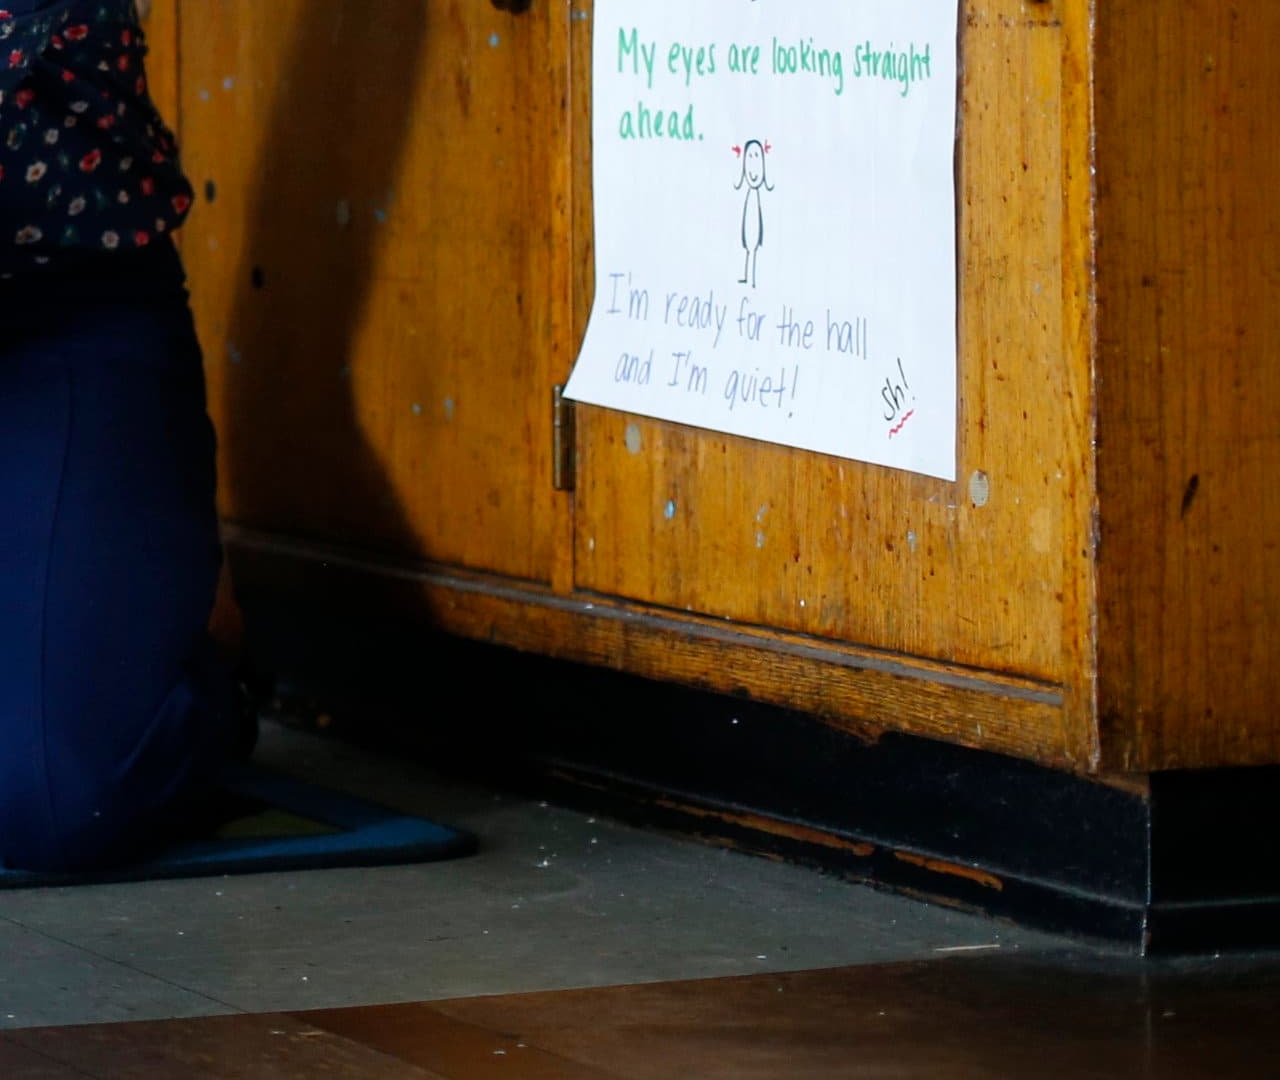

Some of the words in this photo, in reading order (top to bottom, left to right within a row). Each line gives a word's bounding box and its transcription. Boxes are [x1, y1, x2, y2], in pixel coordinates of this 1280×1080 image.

[617, 26, 657, 89] My
[667, 40, 717, 88] eyes
[727, 43, 761, 76] are
[771, 35, 843, 97] looking
[853, 40, 932, 98] straight
[618, 100, 704, 142] ahead.
[606, 272, 649, 320] I'm
[665, 290, 727, 347] ready
[735, 296, 766, 342] for
[776, 304, 814, 350] the
[826, 308, 868, 360] hall
[615, 349, 652, 385] and
[668, 350, 708, 395] I'm
[724, 365, 800, 419] quiet!
